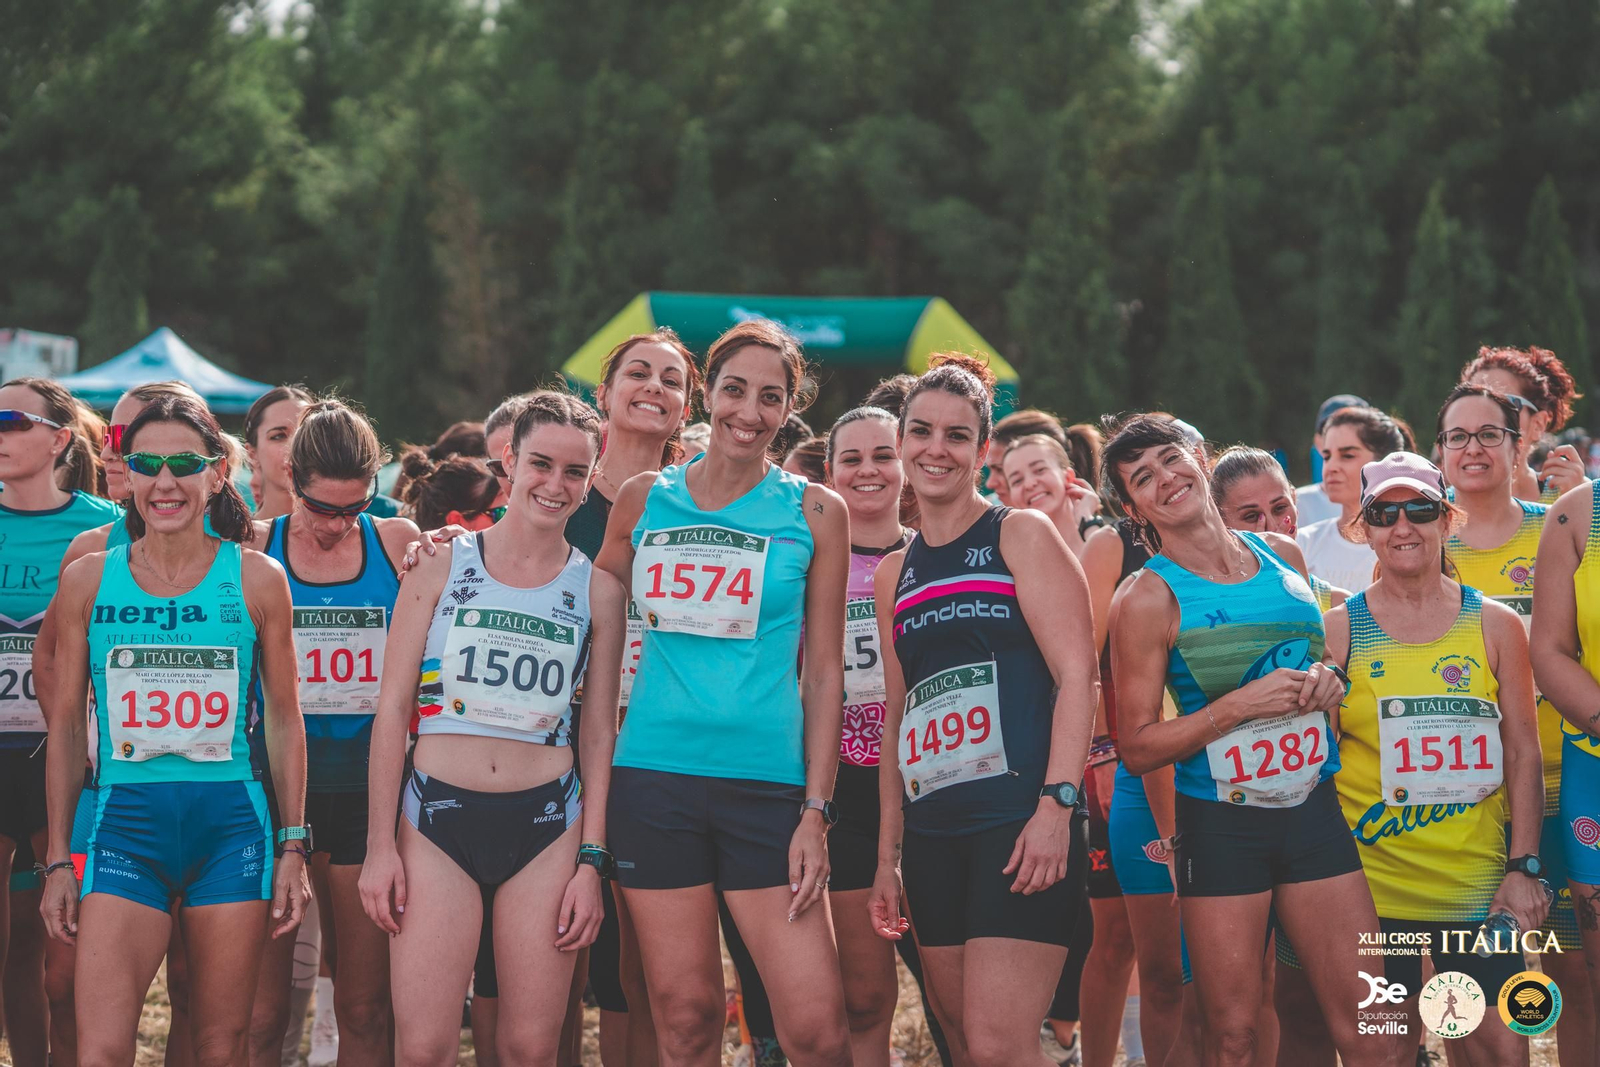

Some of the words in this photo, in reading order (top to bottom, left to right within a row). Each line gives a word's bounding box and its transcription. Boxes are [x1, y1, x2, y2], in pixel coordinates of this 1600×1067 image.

[676, 528, 734, 543] ITÁLICA
[645, 562, 754, 605] 1574
[94, 600, 208, 631] nerja
[301, 611, 357, 625] ITÁLICA
[552, 607, 585, 623] Ayuntamiento
[488, 613, 546, 635] ITÁLICA
[104, 633, 192, 645] ATLETISMO
[490, 639, 518, 648] ATLÉTICO
[519, 644, 551, 655] SALAMANCA
[502, 635, 525, 644] MOLINA
[144, 650, 204, 665] ITÁLICA
[298, 648, 378, 683] 101
[456, 645, 564, 697] 1500
[921, 674, 963, 701] ITÁLICA
[121, 690, 230, 729] 1309
[1414, 699, 1471, 713] ITÁLICA
[1252, 721, 1293, 735] INDEPENDIENTE
[1254, 719, 1277, 728] ROMERO
[906, 706, 991, 766] 1499
[1225, 727, 1324, 785] 1282
[1394, 735, 1494, 774] 1511
[534, 813, 565, 824] VIATOR
